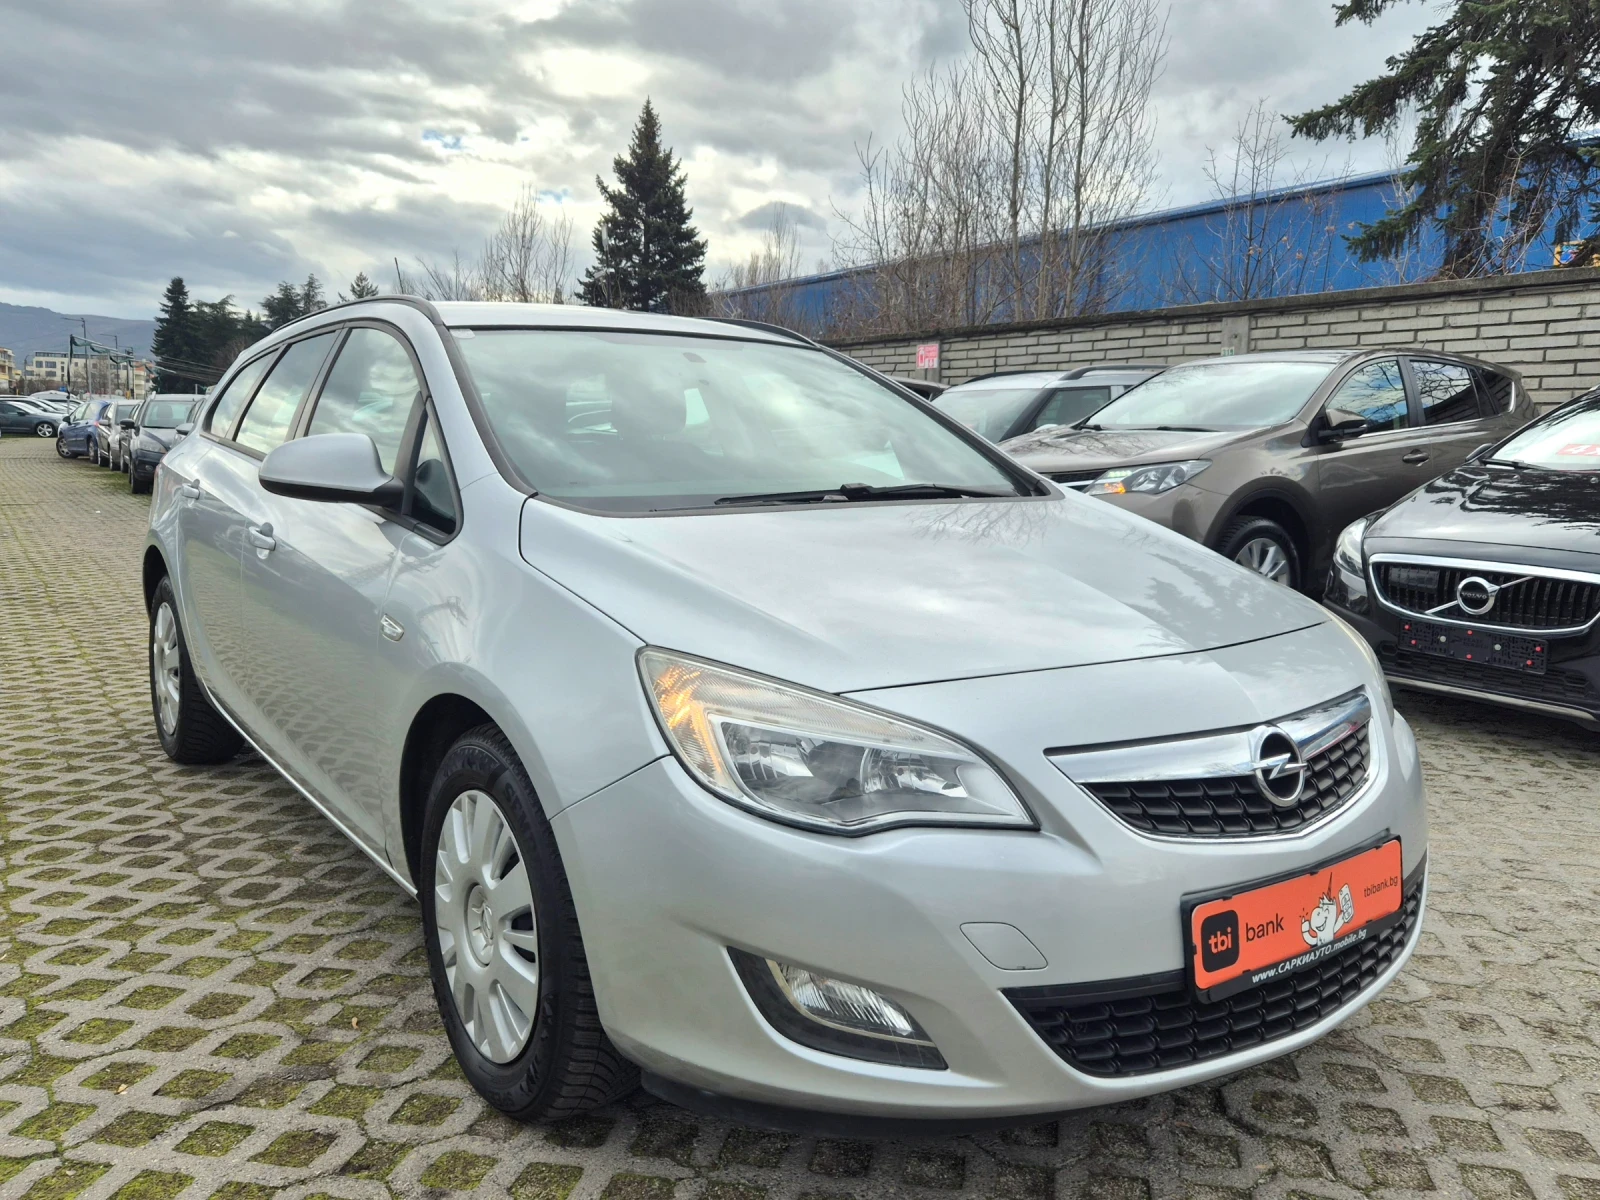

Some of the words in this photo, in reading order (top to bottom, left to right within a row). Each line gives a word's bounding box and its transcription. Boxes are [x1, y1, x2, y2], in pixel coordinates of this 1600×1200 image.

[1461, 591, 1488, 600] VOLVO
[1363, 875, 1398, 898] tbibank.bg
[1208, 926, 1232, 954] tbi
[1245, 913, 1284, 942] bank
